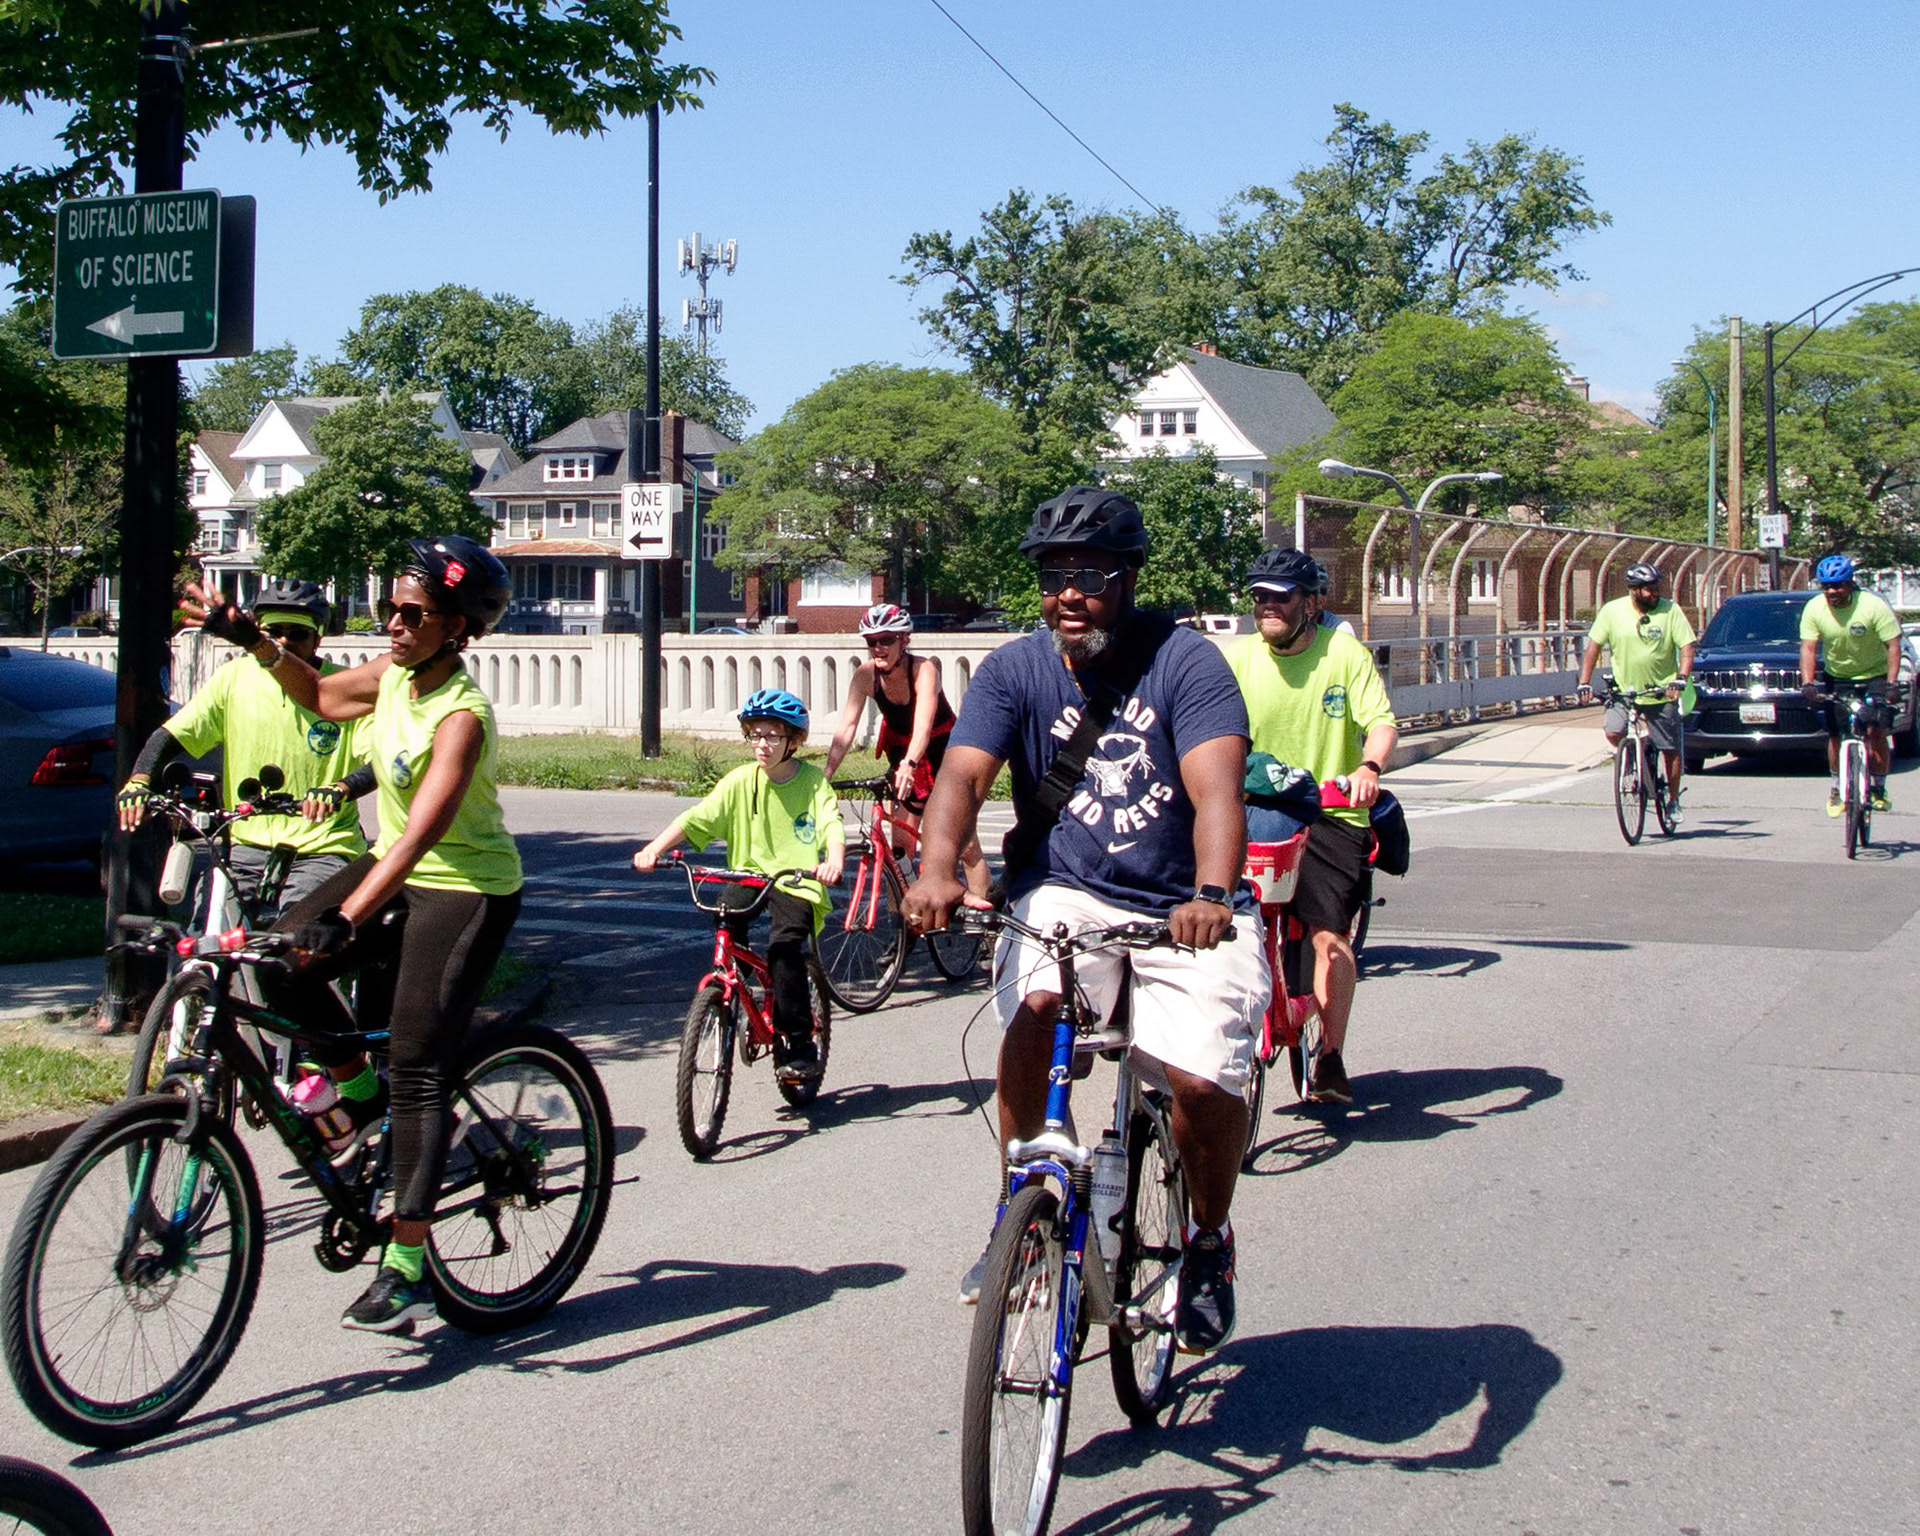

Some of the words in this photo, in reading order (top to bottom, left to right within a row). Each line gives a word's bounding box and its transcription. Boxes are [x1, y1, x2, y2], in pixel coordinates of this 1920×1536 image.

[68, 205, 137, 240] BUFFALO
[143, 199, 209, 234] MUSEUM
[80, 257, 104, 289] OF
[112, 250, 193, 286] SCIENCE
[631, 491, 662, 507] ONE
[631, 511, 663, 526] WAY
[1068, 790, 1103, 825] NO
[1114, 782, 1173, 833] REFS
[1091, 1189, 1120, 1197] COLLEGE
